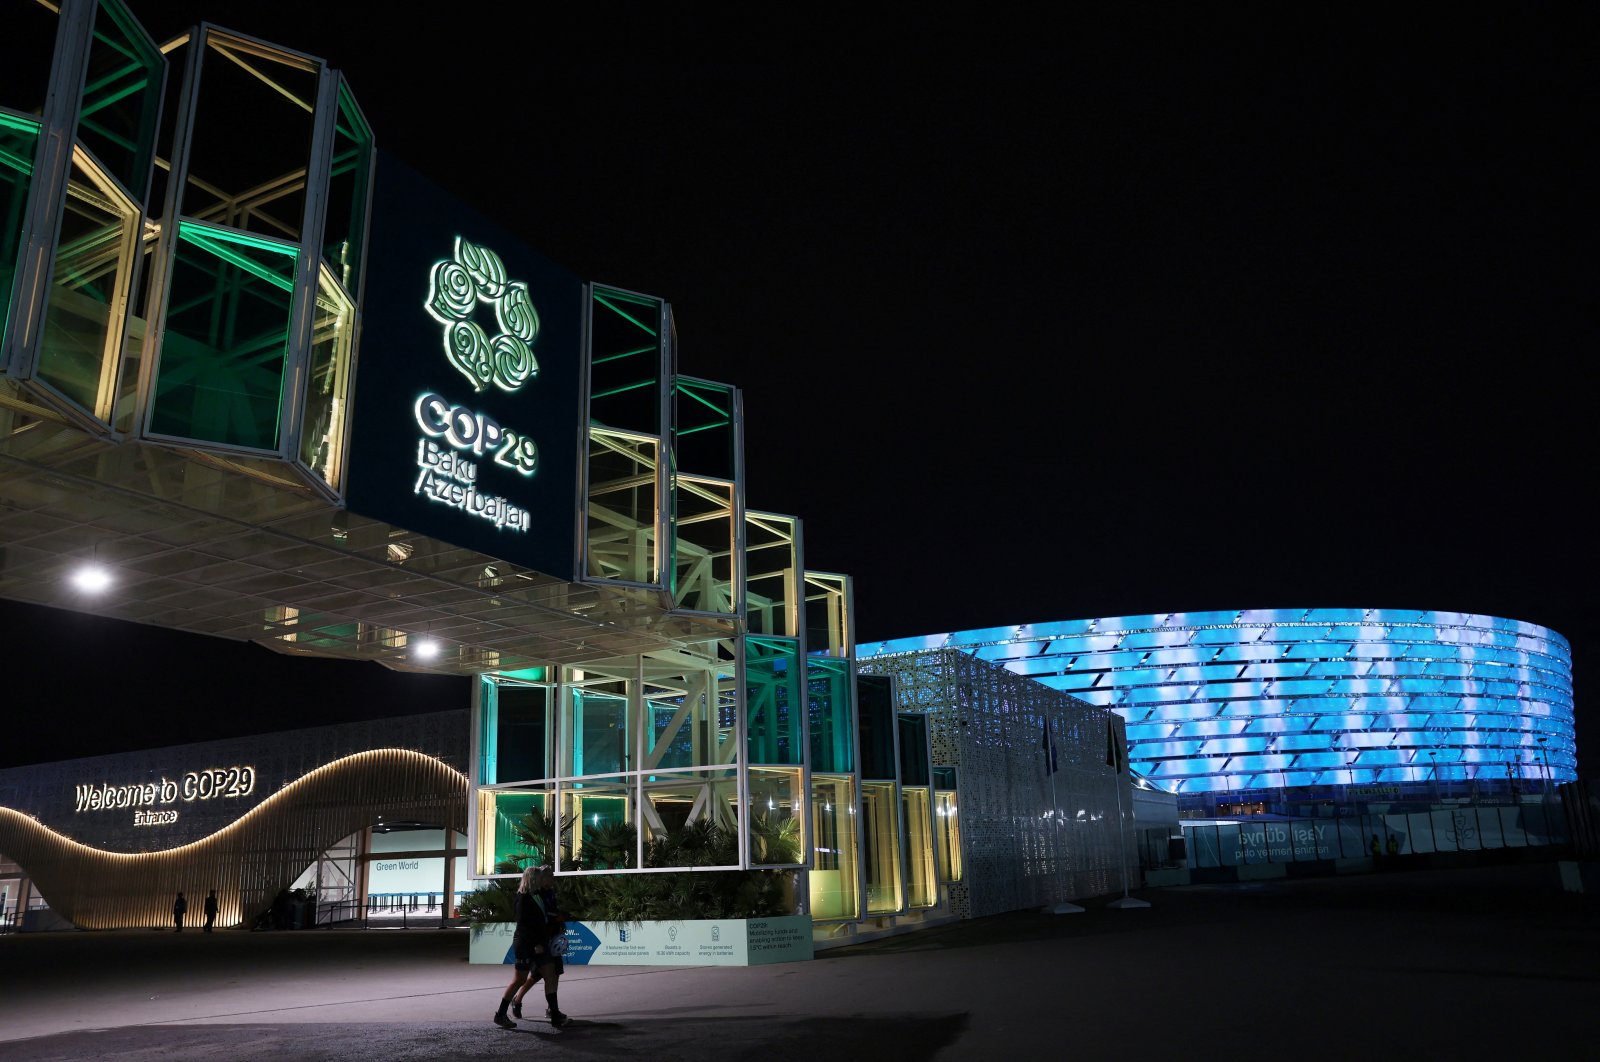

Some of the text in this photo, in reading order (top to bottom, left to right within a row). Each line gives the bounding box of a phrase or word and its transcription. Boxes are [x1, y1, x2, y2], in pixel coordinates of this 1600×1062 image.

[415, 392, 539, 476] COP29
[418, 438, 477, 483] Baku
[414, 468, 532, 532] Azerbaijan
[75, 766, 255, 812] Welcome to COP29
[134, 810, 178, 826] Entrance
[376, 861, 419, 871] Green World
